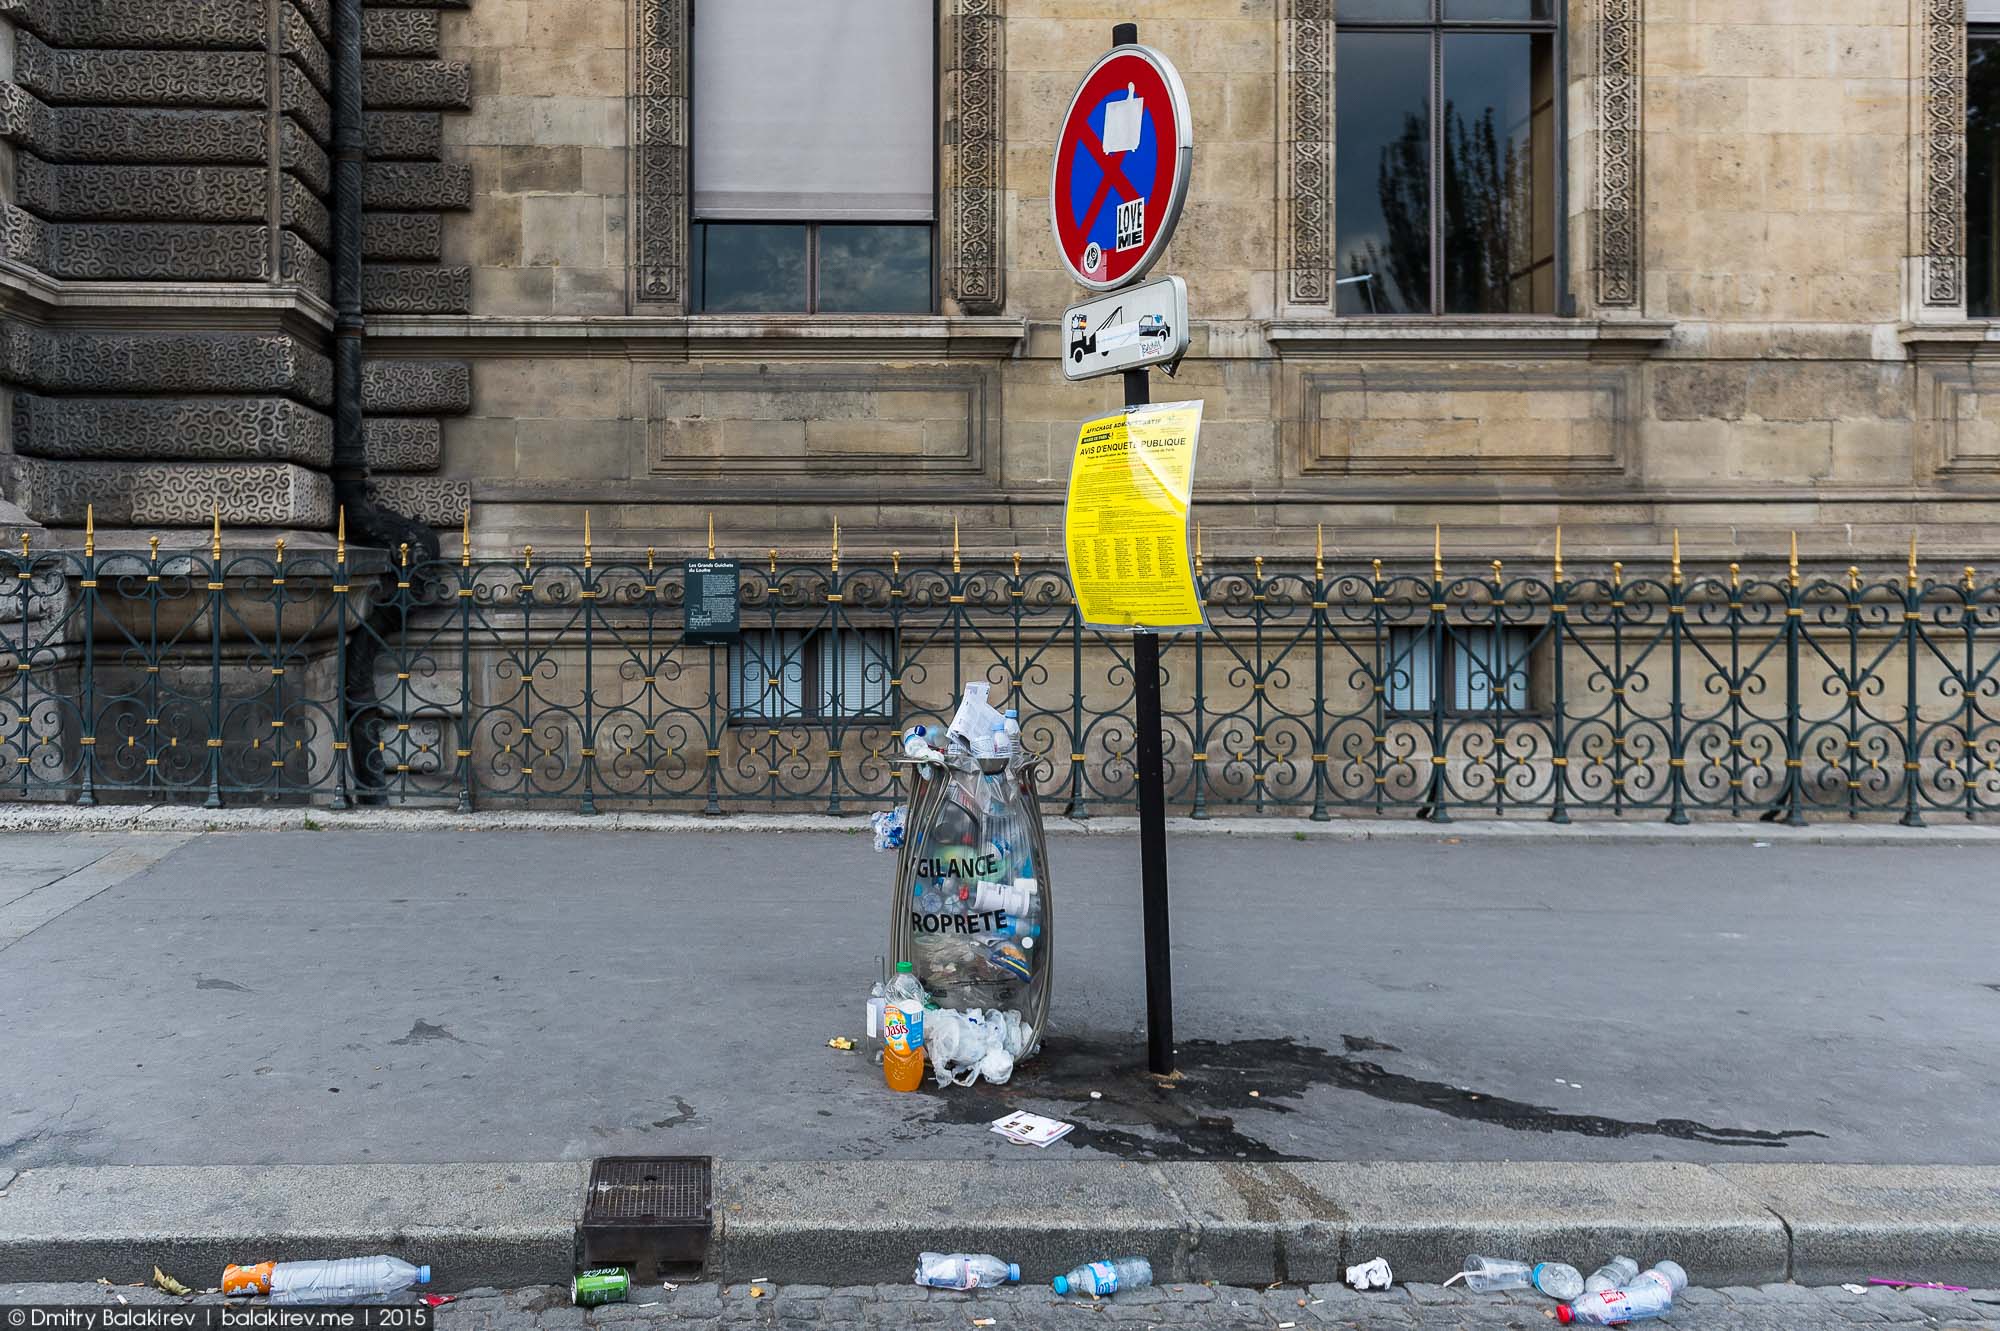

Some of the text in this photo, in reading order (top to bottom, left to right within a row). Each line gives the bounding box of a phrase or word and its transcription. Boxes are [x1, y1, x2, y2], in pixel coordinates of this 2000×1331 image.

[1118, 201, 1142, 234] LOVE
[1118, 230, 1142, 249] ME
[1087, 424, 1113, 433] AFFICHAGE
[1080, 447, 1095, 455] AVIS
[1141, 438, 1187, 448] PUBLIQUE
[907, 853, 998, 878] GILANCE
[911, 908, 1008, 934] ROPRETE
